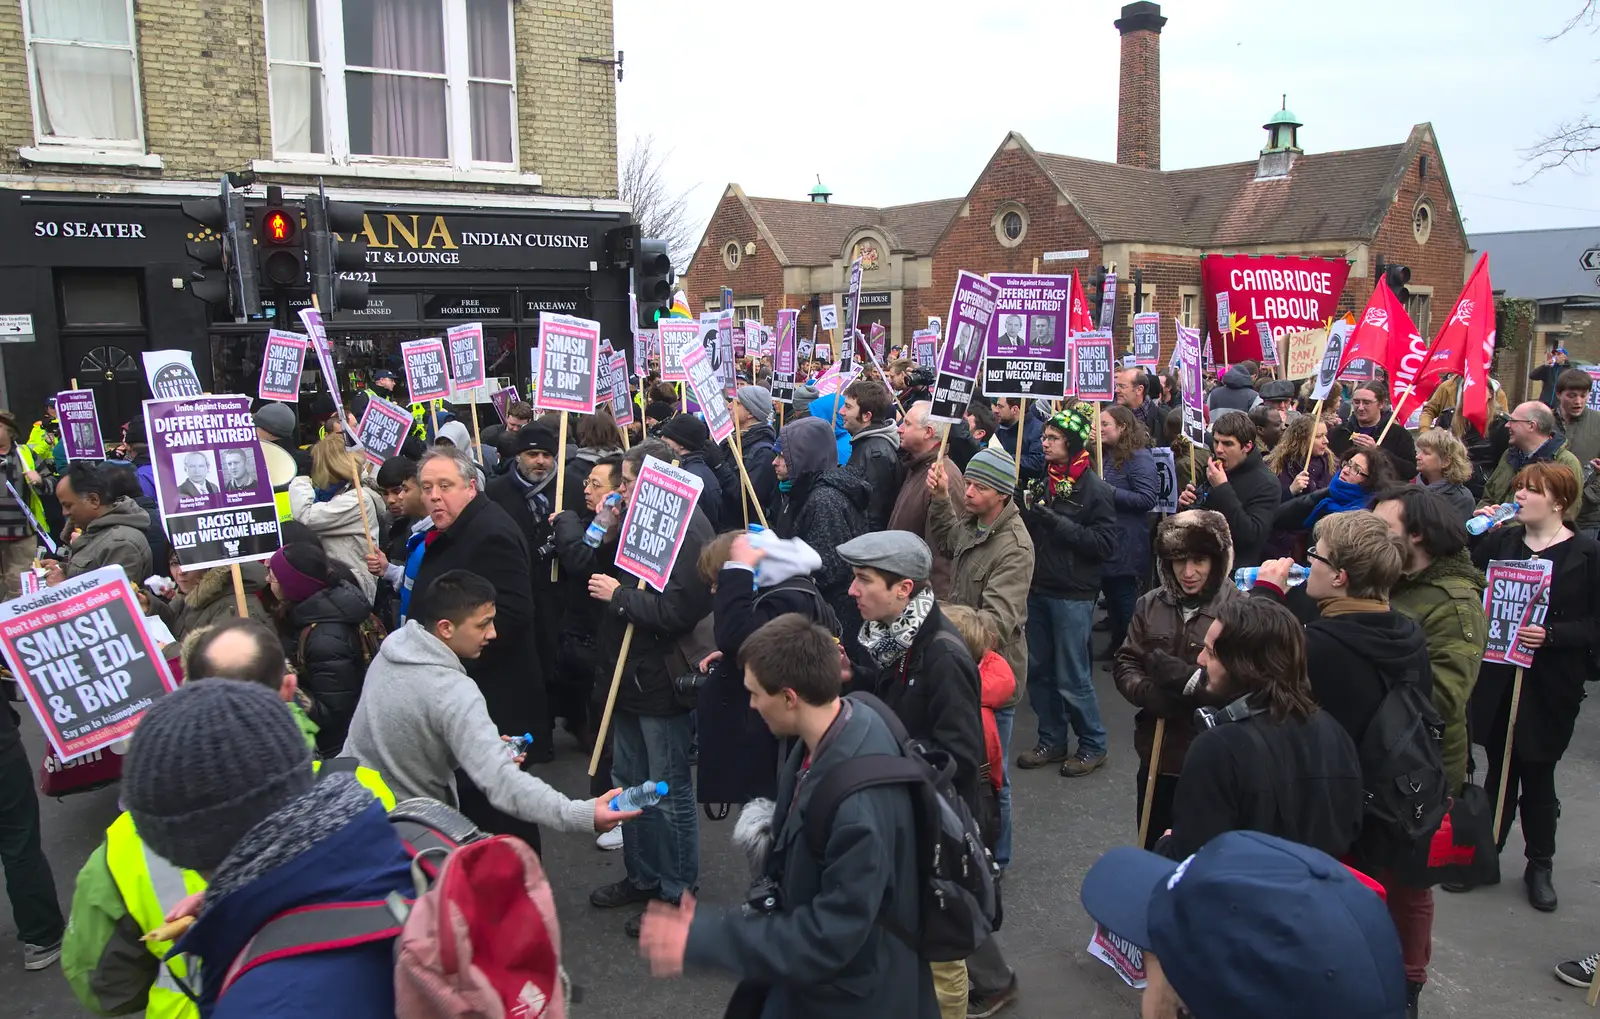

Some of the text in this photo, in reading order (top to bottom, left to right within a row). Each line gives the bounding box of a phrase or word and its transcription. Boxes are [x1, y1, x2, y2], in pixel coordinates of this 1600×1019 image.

[35, 221, 146, 238] 50 SEATER
[461, 232, 589, 248] INDIAN CUISINE
[384, 252, 395, 263] &
[398, 252, 460, 264] LOUNGE
[1230, 269, 1332, 295] CAMBRIDGE
[871, 295, 888, 303] HOUSE
[998, 288, 1066, 300] IFFERENT FACES
[527, 302, 577, 310] TAKEAWAY
[997, 300, 1061, 312] SAME HATRED!
[1251, 297, 1319, 322] LABOUR
[546, 333, 586, 356] SMASH
[663, 331, 693, 344] SMASH
[269, 345, 298, 361] SMASH
[664, 343, 681, 356] THE
[1078, 346, 1105, 360] SMASH
[268, 358, 298, 374] THE EDL
[408, 351, 438, 367] SMASH
[545, 352, 590, 375] THE EDL
[665, 355, 672, 368] &
[1006, 361, 1047, 372] RACIST EDL
[1079, 360, 1110, 372] THE EDL
[265, 371, 292, 386] & BNP
[409, 362, 443, 378] THE EDL
[988, 370, 1063, 382] NOT WELCOME HERE!
[412, 375, 438, 390] & BNP
[543, 370, 580, 391] & BNP
[1079, 373, 1104, 386] & BNP
[174, 402, 241, 413] Unite Against Fascism
[154, 413, 255, 433] DIFFERENT FACE
[368, 408, 400, 434] SMASH
[165, 427, 257, 448] SAME HATRED!
[364, 419, 398, 447] THE EDL
[368, 435, 388, 453] BNP
[639, 482, 682, 519] SMASH
[197, 511, 255, 529] RACIST EDL
[632, 502, 678, 543] THE EDL
[172, 521, 277, 546] NOT WELCOME HERE!
[626, 524, 666, 558] & BNP
[1494, 569, 1507, 578] Don't
[1508, 571, 1516, 579] let
[4, 588, 121, 636] Don't let the racists divide us
[1492, 599, 1524, 621] THE
[16, 607, 118, 667] SMASH
[1488, 620, 1502, 640] &
[29, 633, 145, 696] THE EDL
[48, 669, 132, 724] & BNP
[62, 697, 153, 740] Say no to Islamophobia
